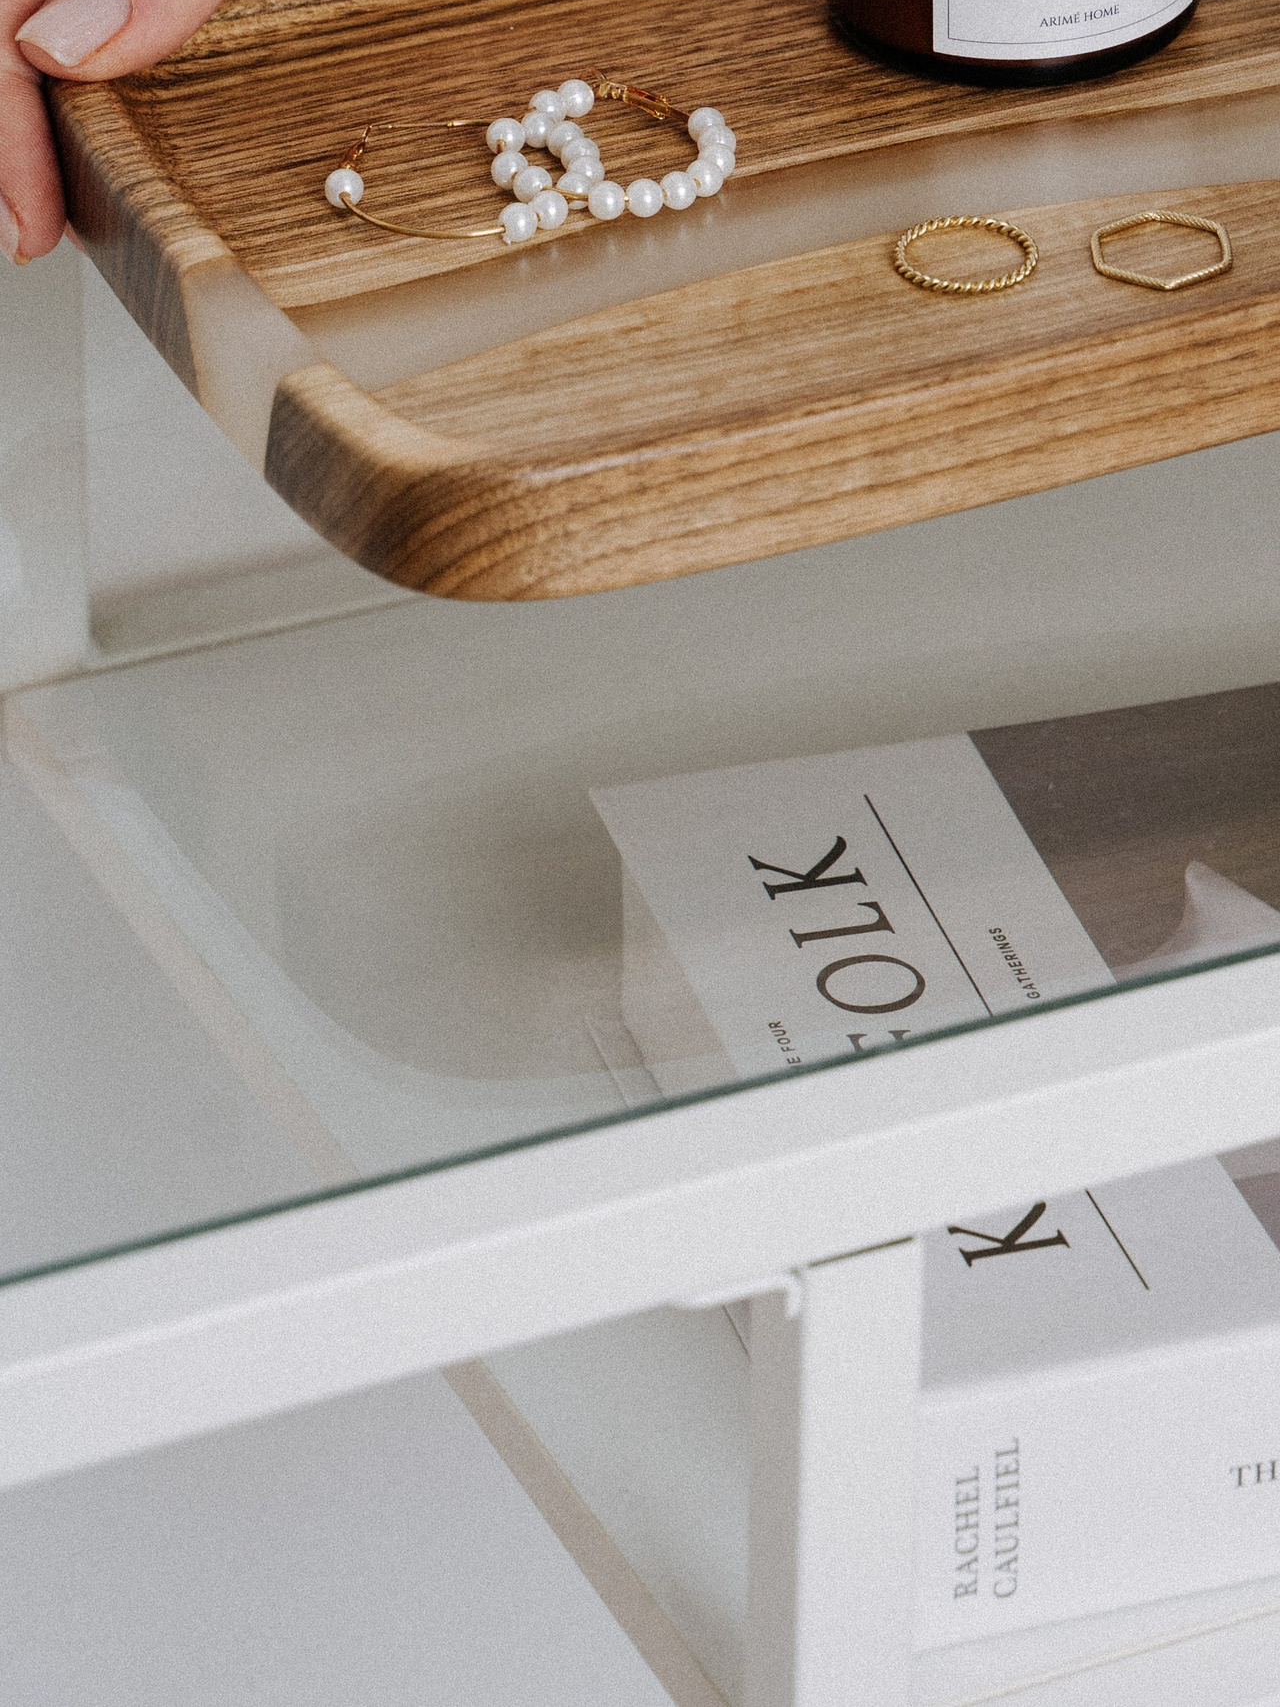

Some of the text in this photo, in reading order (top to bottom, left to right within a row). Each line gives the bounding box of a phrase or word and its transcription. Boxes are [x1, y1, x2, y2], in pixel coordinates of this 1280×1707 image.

[1084, 4, 1120, 23] HOME
[988, 926, 1041, 1000] GATHERINGS
[768, 1021, 797, 1053] FOUR
[954, 1464, 981, 1600] RACHEL
[993, 1436, 1021, 1600] CAULFIEL
